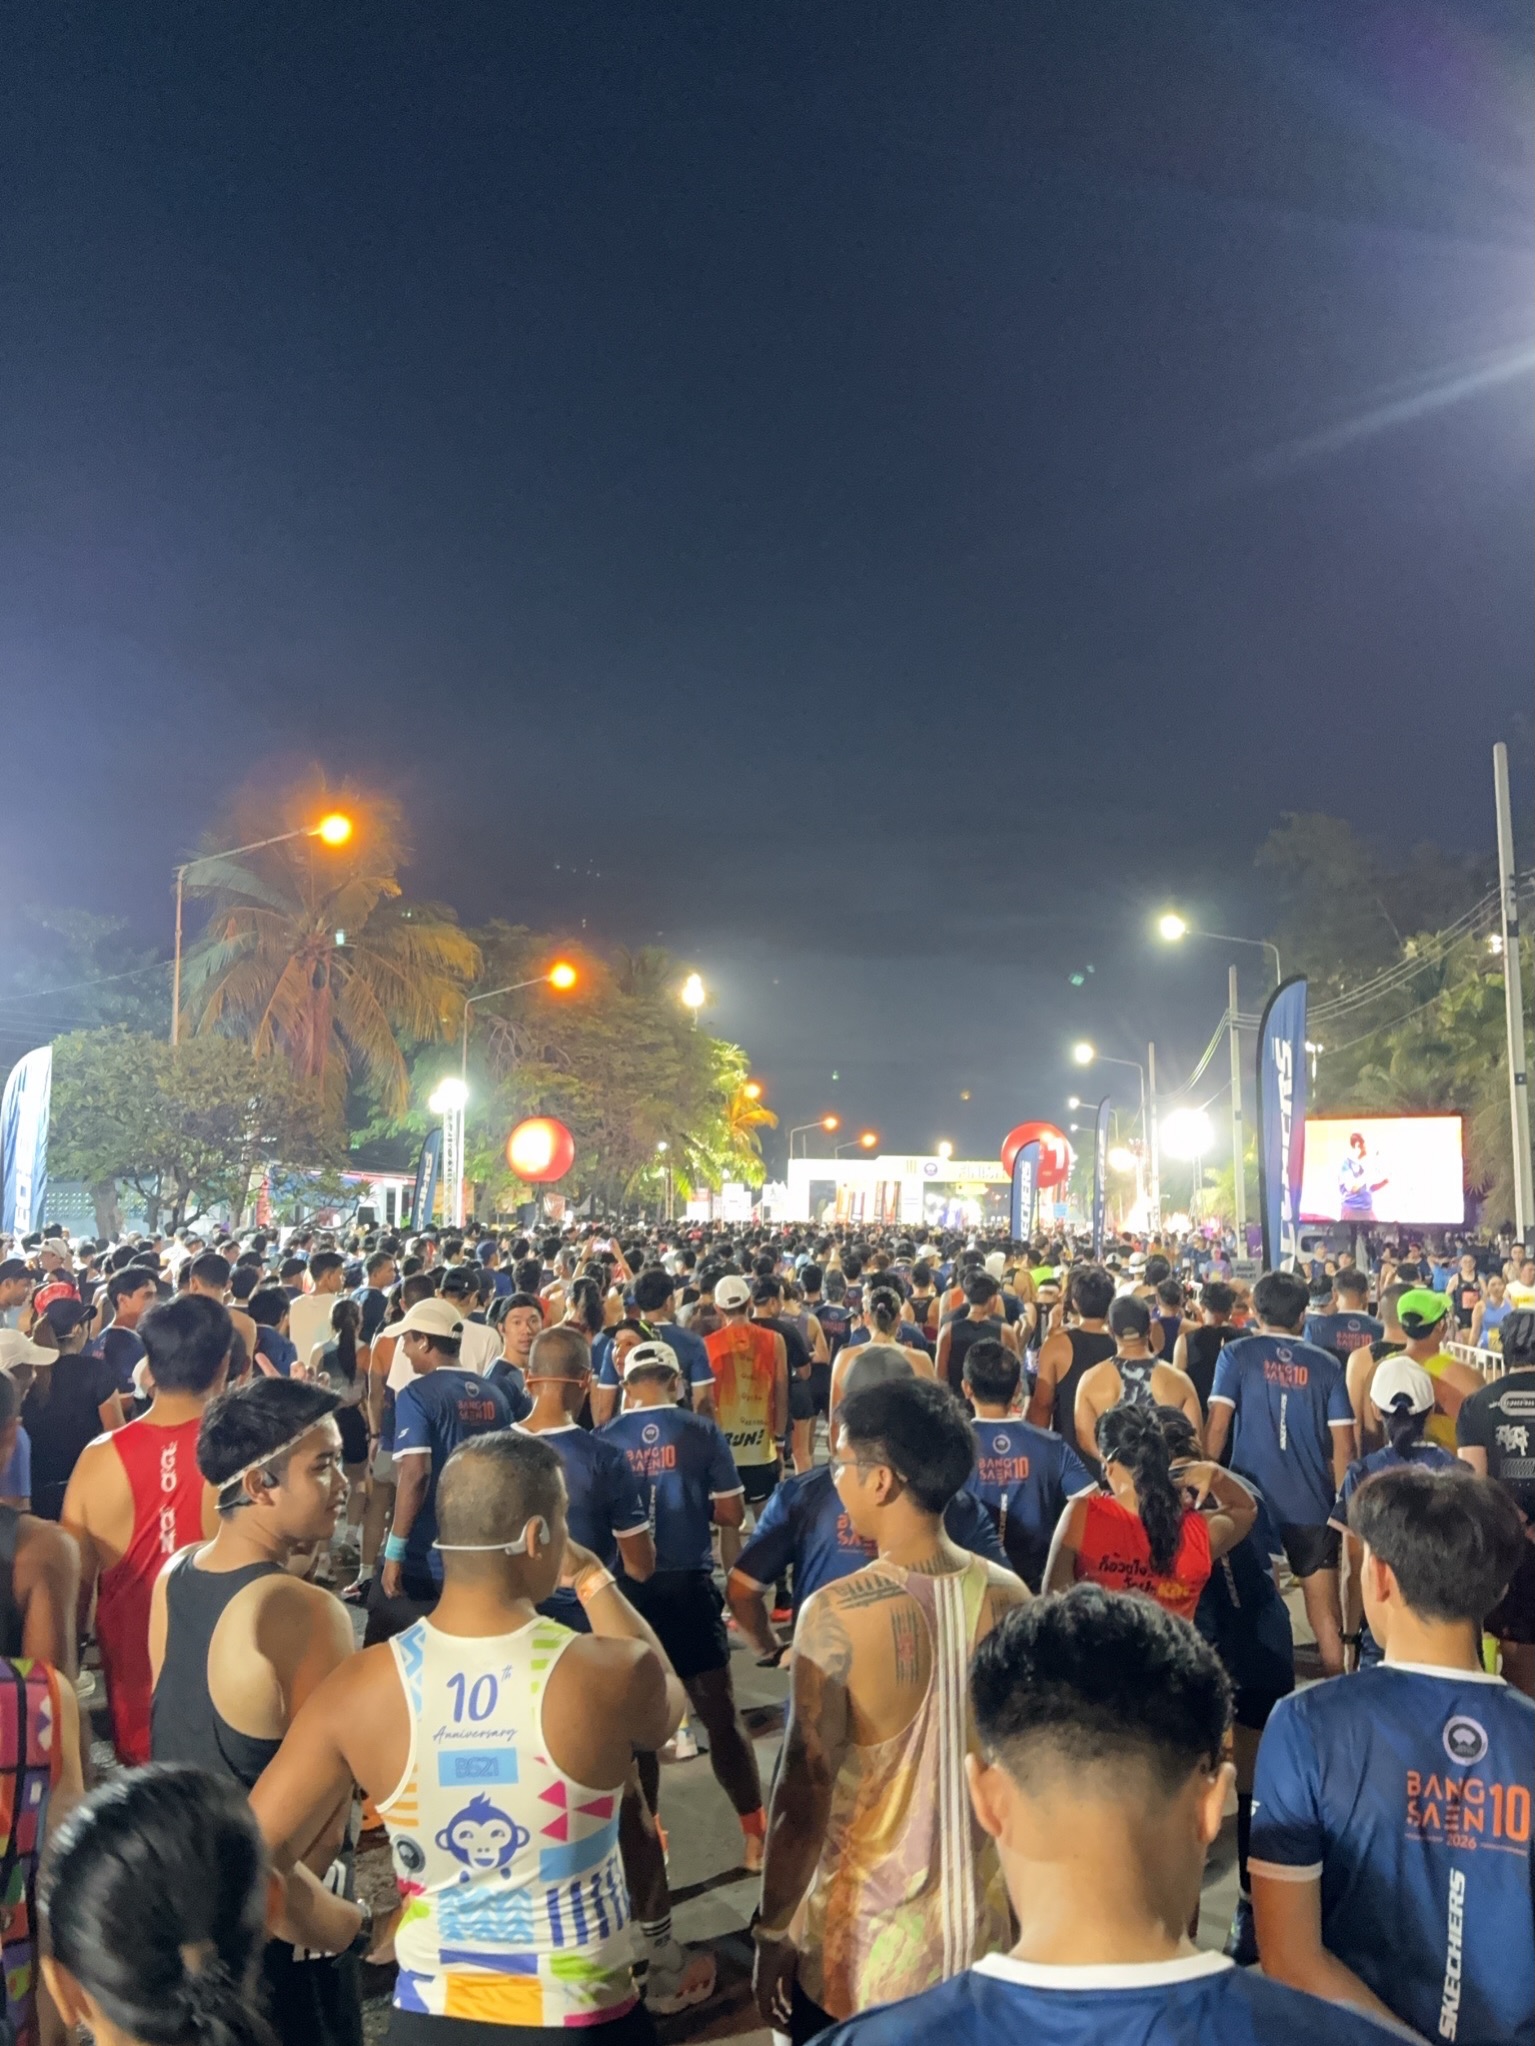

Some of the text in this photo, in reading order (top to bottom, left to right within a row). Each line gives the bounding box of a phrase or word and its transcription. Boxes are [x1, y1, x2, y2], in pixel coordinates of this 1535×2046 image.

[1294, 1366, 1308, 1386] 10
[482, 1400, 496, 1421] 10
[660, 1445, 677, 1469] 10
[978, 1456, 1030, 1479] BANG 10
[979, 1469, 1013, 1481] SAEN
[433, 1725, 518, 1744] Anniversary
[1406, 1770, 1531, 1842] BANG 10
[1406, 1801, 1484, 1834] SAEN
[1438, 1867, 1466, 2043] SKECHERS
